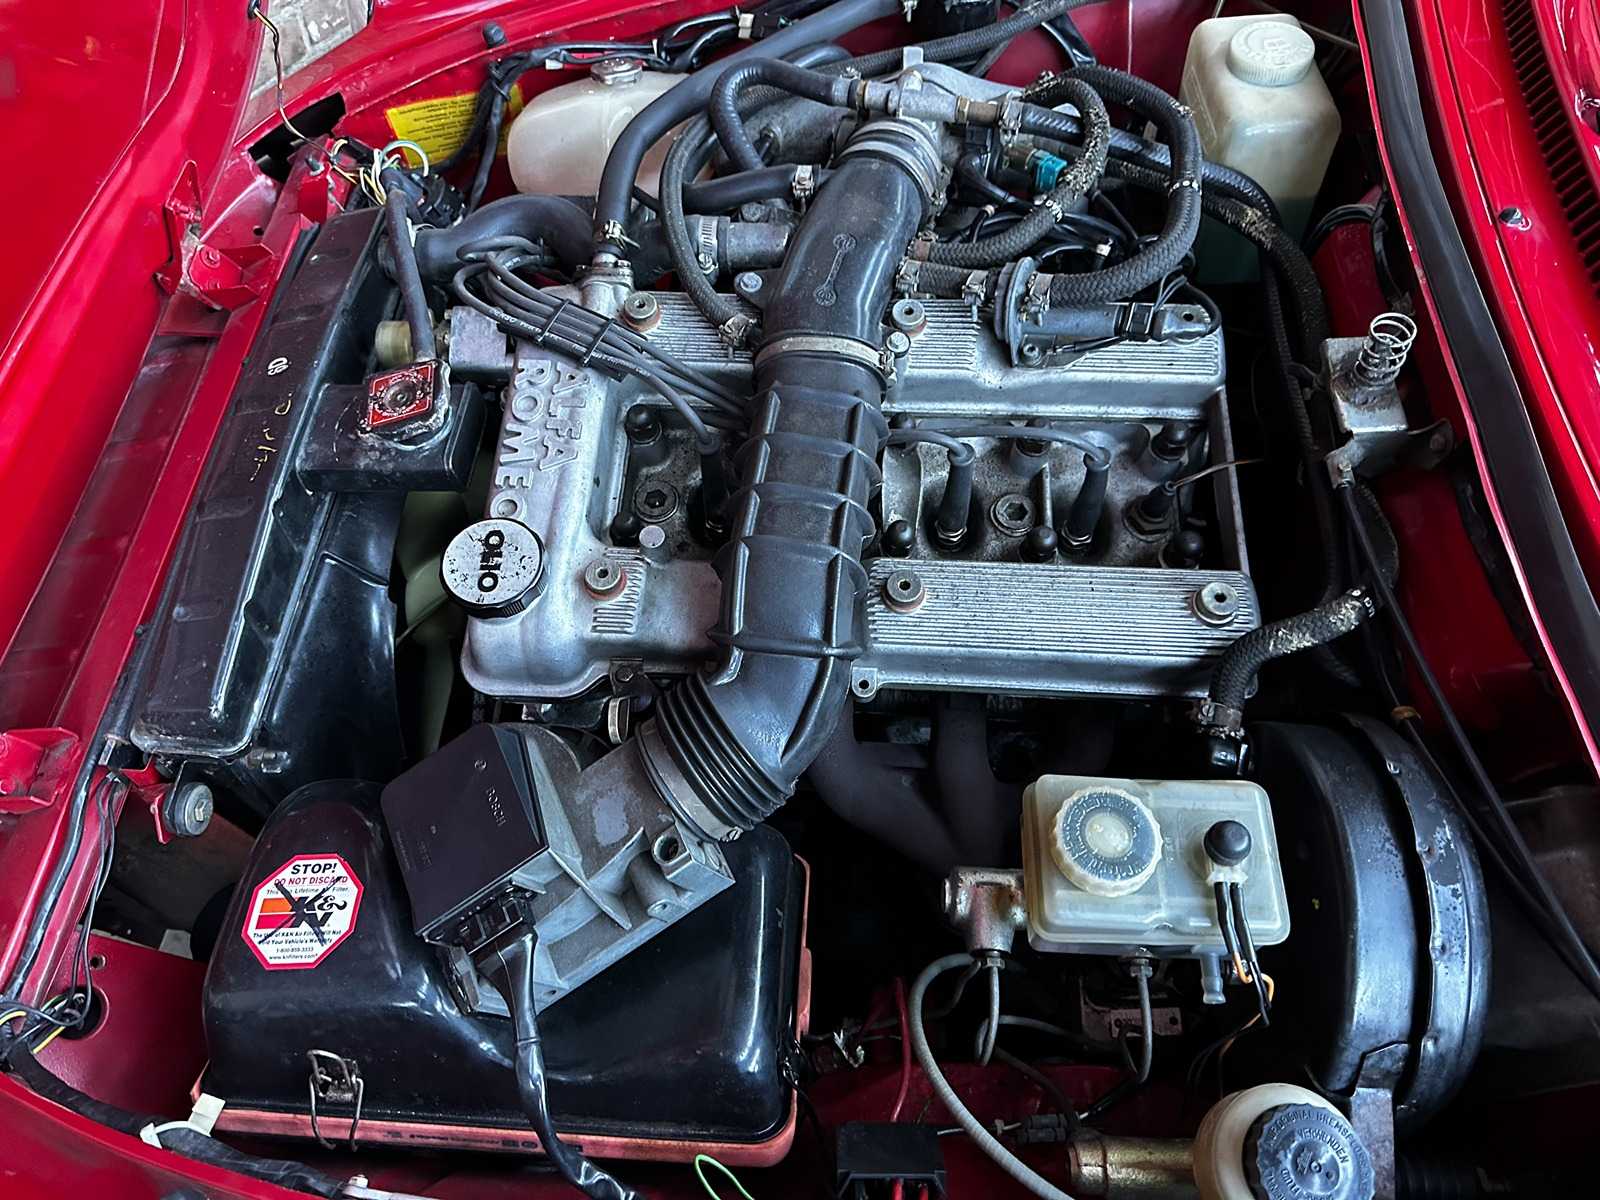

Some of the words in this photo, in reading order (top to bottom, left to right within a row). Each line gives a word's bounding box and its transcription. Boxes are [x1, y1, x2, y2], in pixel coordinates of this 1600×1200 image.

[490, 359, 551, 519] ROMEO
[538, 361, 590, 472] ALFA
[477, 530, 505, 593] OLIO
[288, 877, 308, 886] NOT
[309, 876, 349, 885] DISCAD
[291, 863, 337, 875] STOP!
